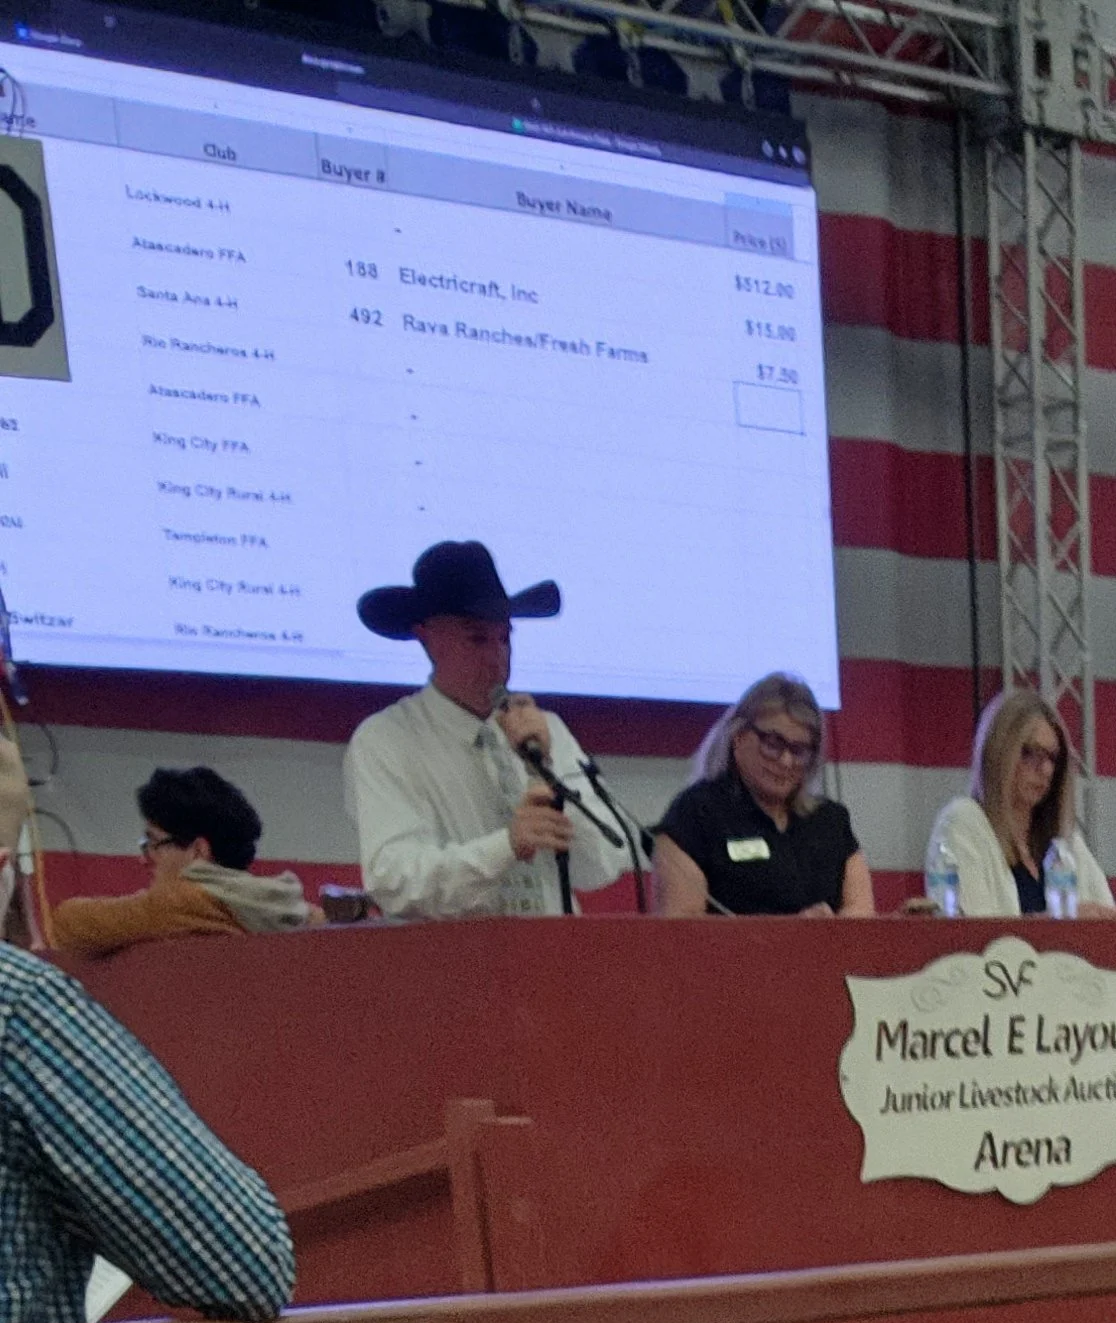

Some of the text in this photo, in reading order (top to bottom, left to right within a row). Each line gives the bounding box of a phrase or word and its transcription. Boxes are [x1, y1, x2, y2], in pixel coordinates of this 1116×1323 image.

[203, 143, 237, 161] Club
[321, 158, 371, 184] Buyer
[516, 190, 613, 222] Buyer Name
[217, 248, 247, 264] FFA
[346, 259, 539, 303] 188 Electricraft, Inc
[136, 285, 179, 302] Santa
[184, 291, 211, 307] Ana
[141, 334, 167, 349] Rio
[170, 337, 247, 359] Rancheros
[350, 306, 648, 365] 492 Rava Ranches/Fresh Farms
[233, 391, 261, 408] FFA
[152, 431, 250, 453] King City FFA
[157, 480, 192, 498] King
[195, 483, 222, 500] City
[241, 533, 268, 549] FFA
[875, 1013, 993, 1063] Marcel
[1007, 1013, 1026, 1056] E
[879, 1082, 952, 1116] Junior
[958, 1076, 1059, 1110] Livestock
[974, 1129, 1073, 1173] Arena
